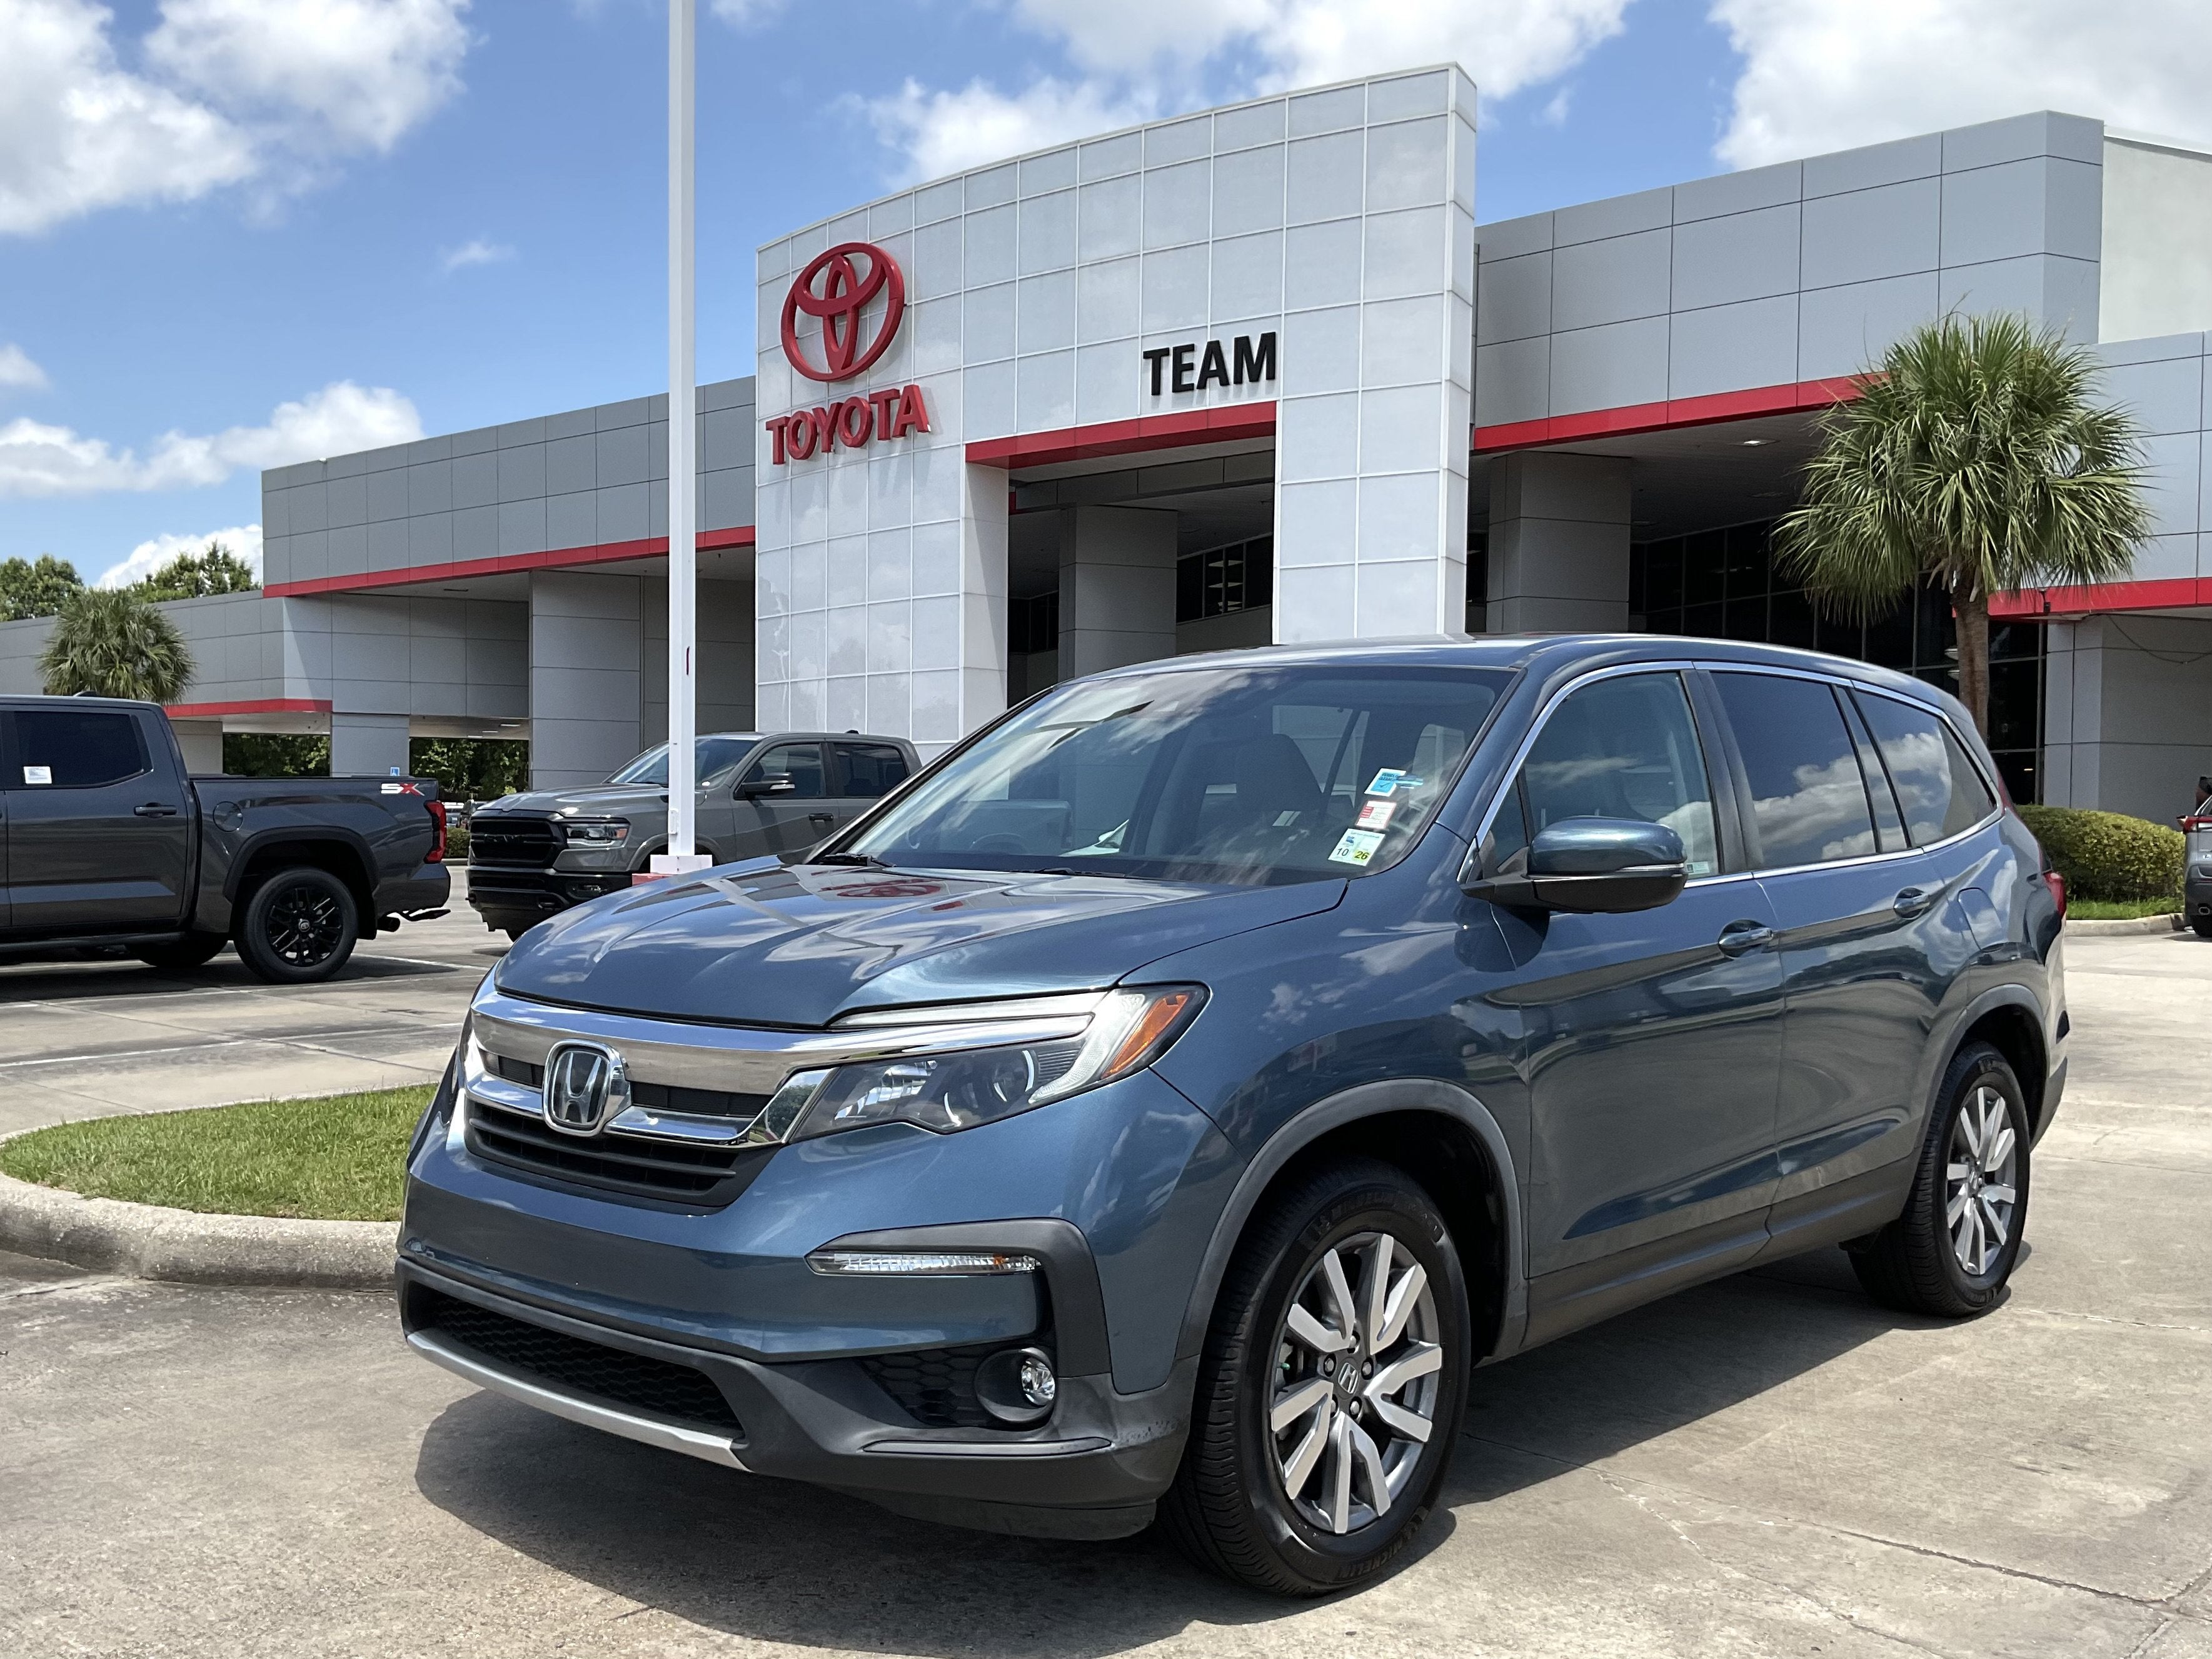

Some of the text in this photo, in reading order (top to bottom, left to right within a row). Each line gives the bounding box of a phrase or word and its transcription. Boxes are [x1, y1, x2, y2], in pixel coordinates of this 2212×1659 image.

[1143, 331, 1276, 396] TEAM
[766, 384, 930, 464] TOYOTA
[1337, 848, 1370, 860] 10 26
